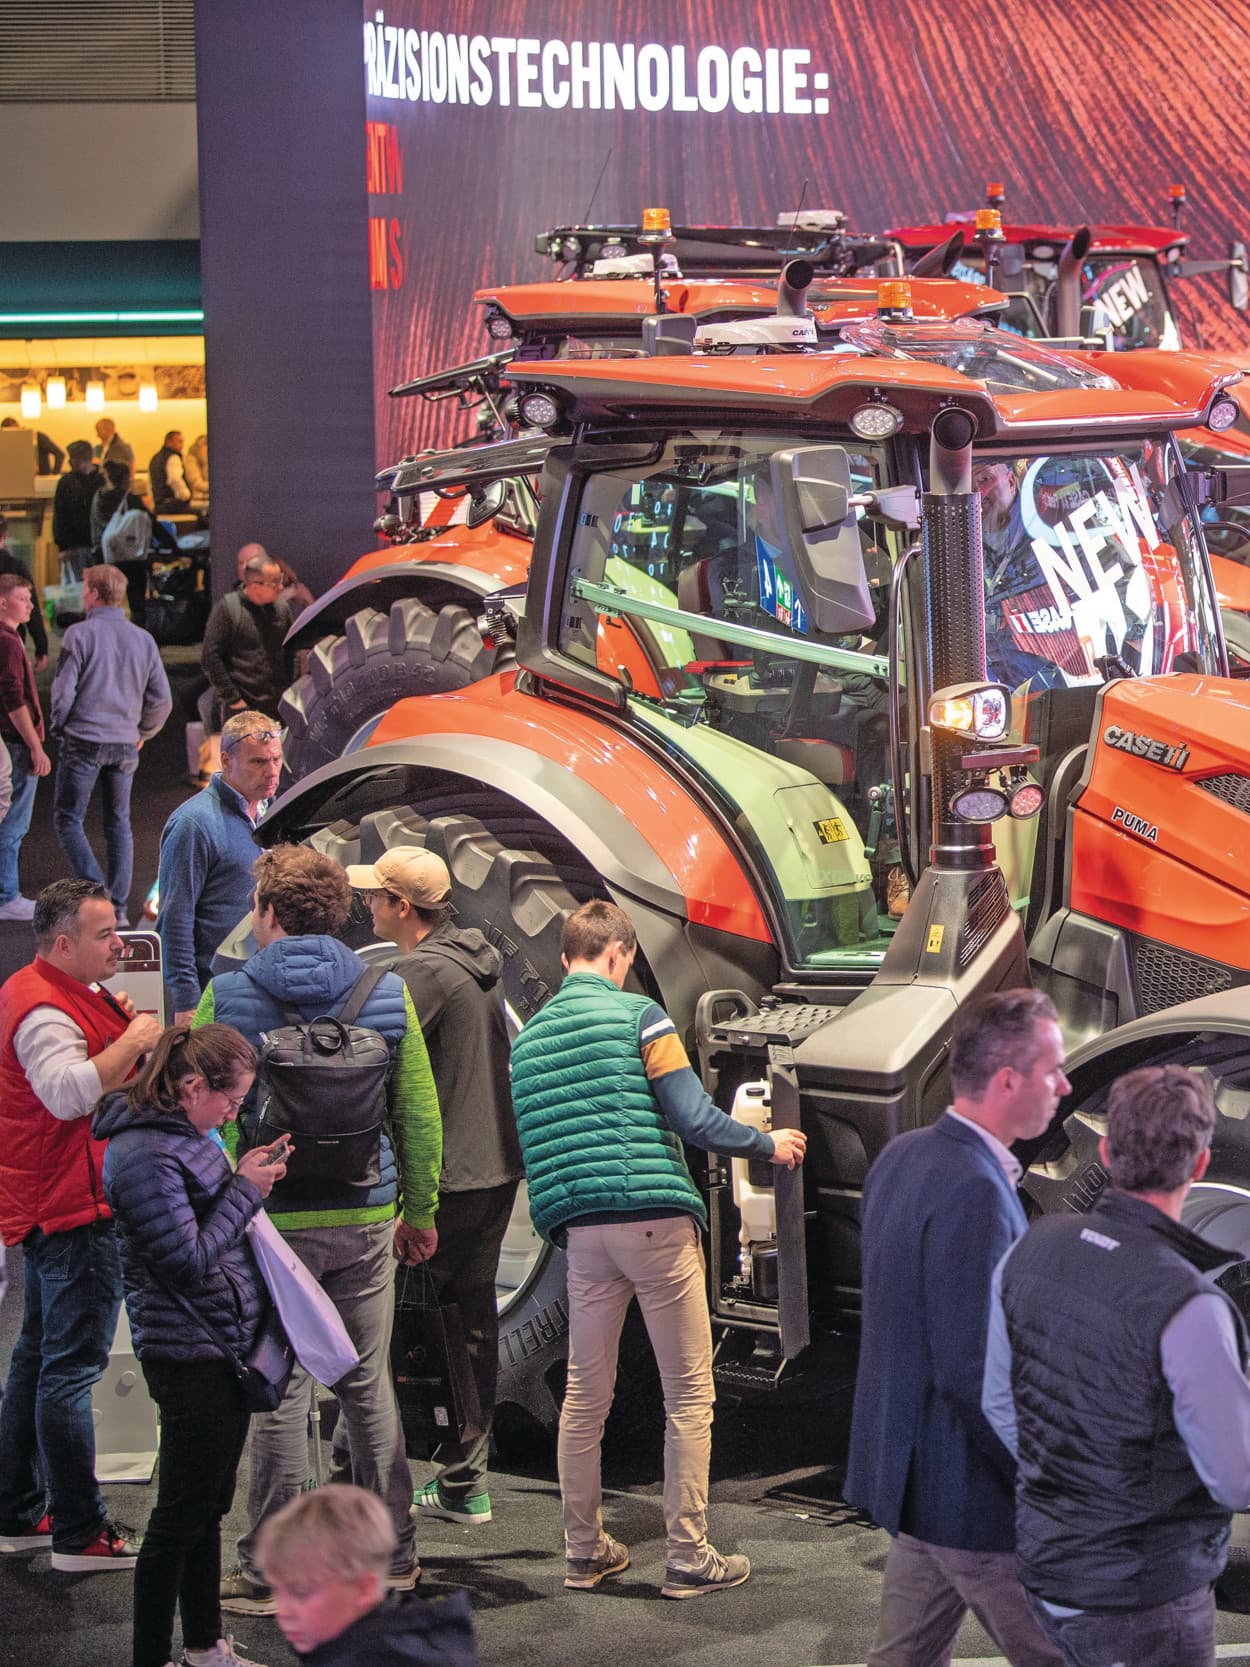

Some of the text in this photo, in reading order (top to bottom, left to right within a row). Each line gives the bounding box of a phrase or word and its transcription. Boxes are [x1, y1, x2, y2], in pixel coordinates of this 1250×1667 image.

[1094, 265, 1149, 327] NEW
[1030, 461, 1161, 614] NEW
[1104, 725, 1168, 760] CASE
[1112, 806, 1159, 843] PUMA
